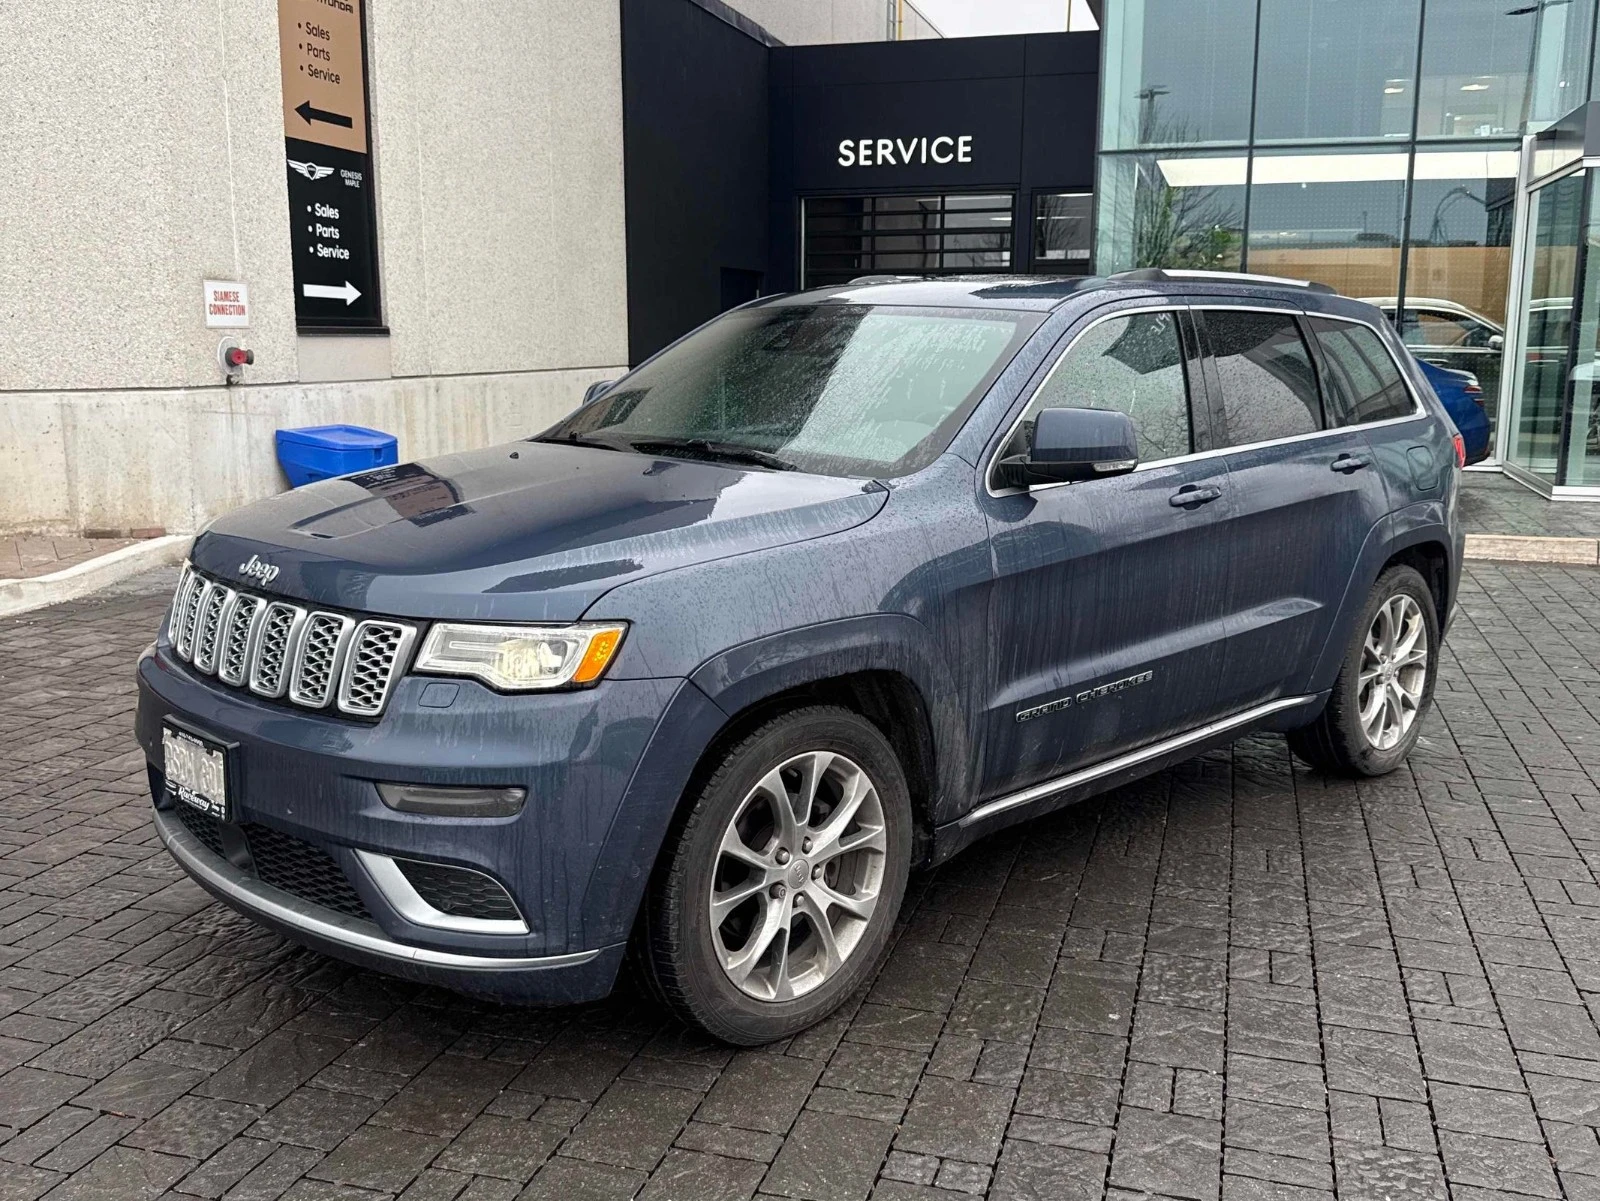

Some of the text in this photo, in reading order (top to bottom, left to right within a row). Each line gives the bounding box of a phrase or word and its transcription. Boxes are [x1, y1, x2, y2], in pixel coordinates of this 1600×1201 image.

[305, 21, 331, 41] Sales
[306, 42, 331, 61] Parts
[307, 63, 341, 85] Service
[837, 135, 973, 167] SERVICE
[340, 168, 363, 181] GENESIS
[314, 202, 340, 220] Sales
[315, 222, 340, 240] Parts
[316, 243, 350, 260] Service
[213, 289, 240, 303] SIAMESE
[208, 303, 246, 316] CONNECTION
[238, 554, 280, 587] Jeep
[1015, 670, 1153, 723] GRAND CHEROKEE
[177, 785, 210, 811] Raceway
